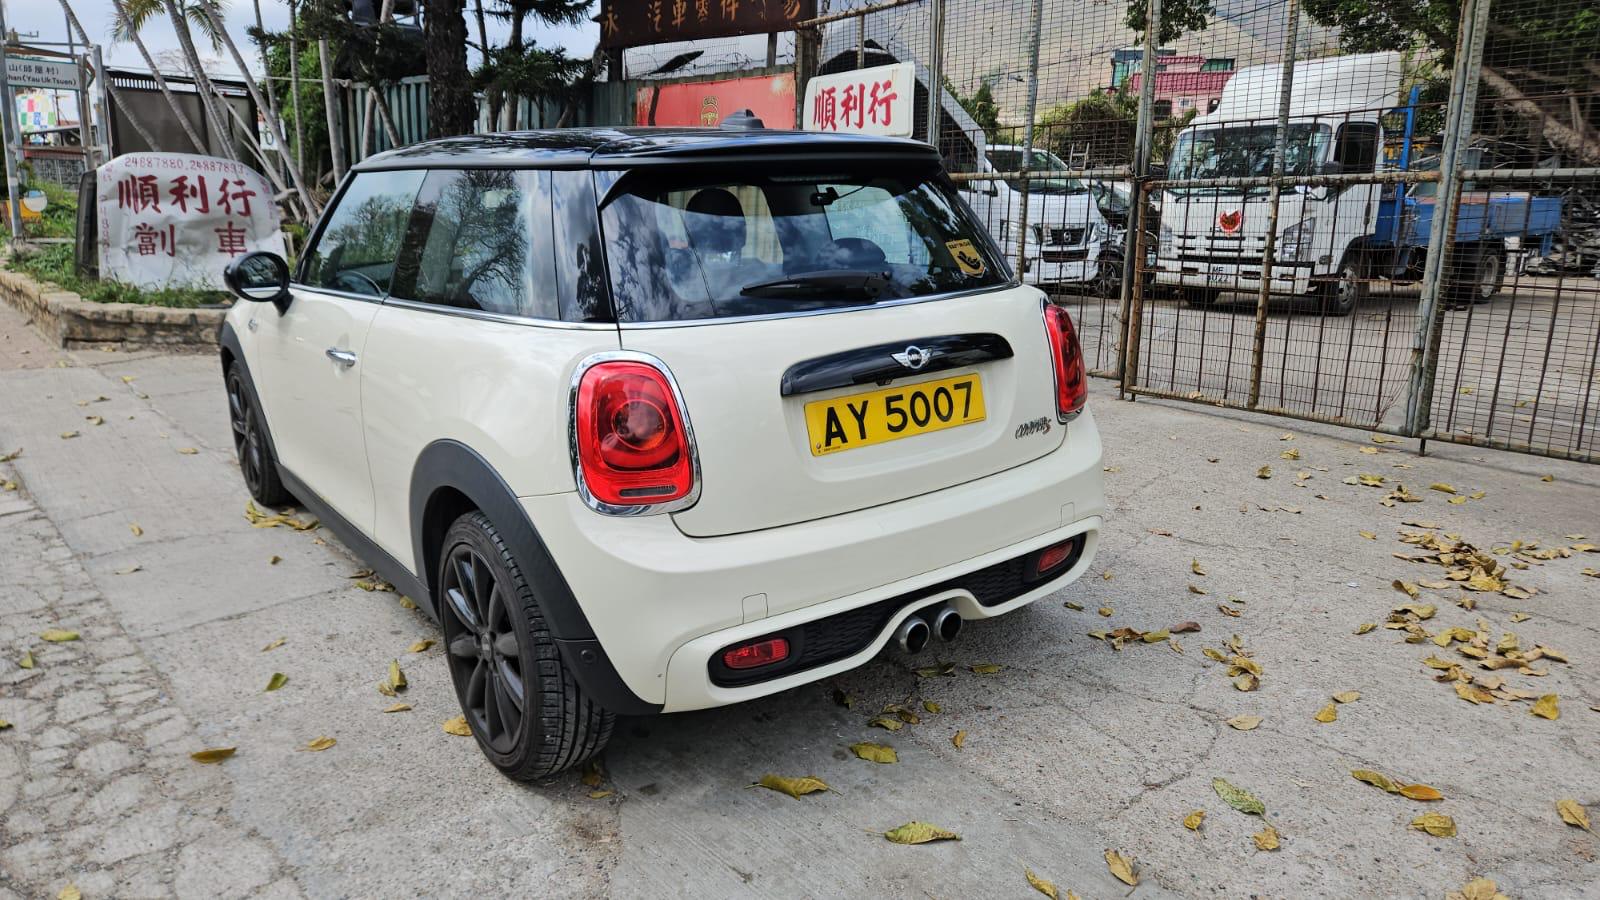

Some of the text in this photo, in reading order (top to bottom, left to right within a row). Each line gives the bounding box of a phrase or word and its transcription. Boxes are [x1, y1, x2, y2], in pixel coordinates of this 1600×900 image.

[813, 79, 898, 131] 順利行
[118, 174, 256, 216] 順利行
[824, 380, 973, 448] AY 5007
